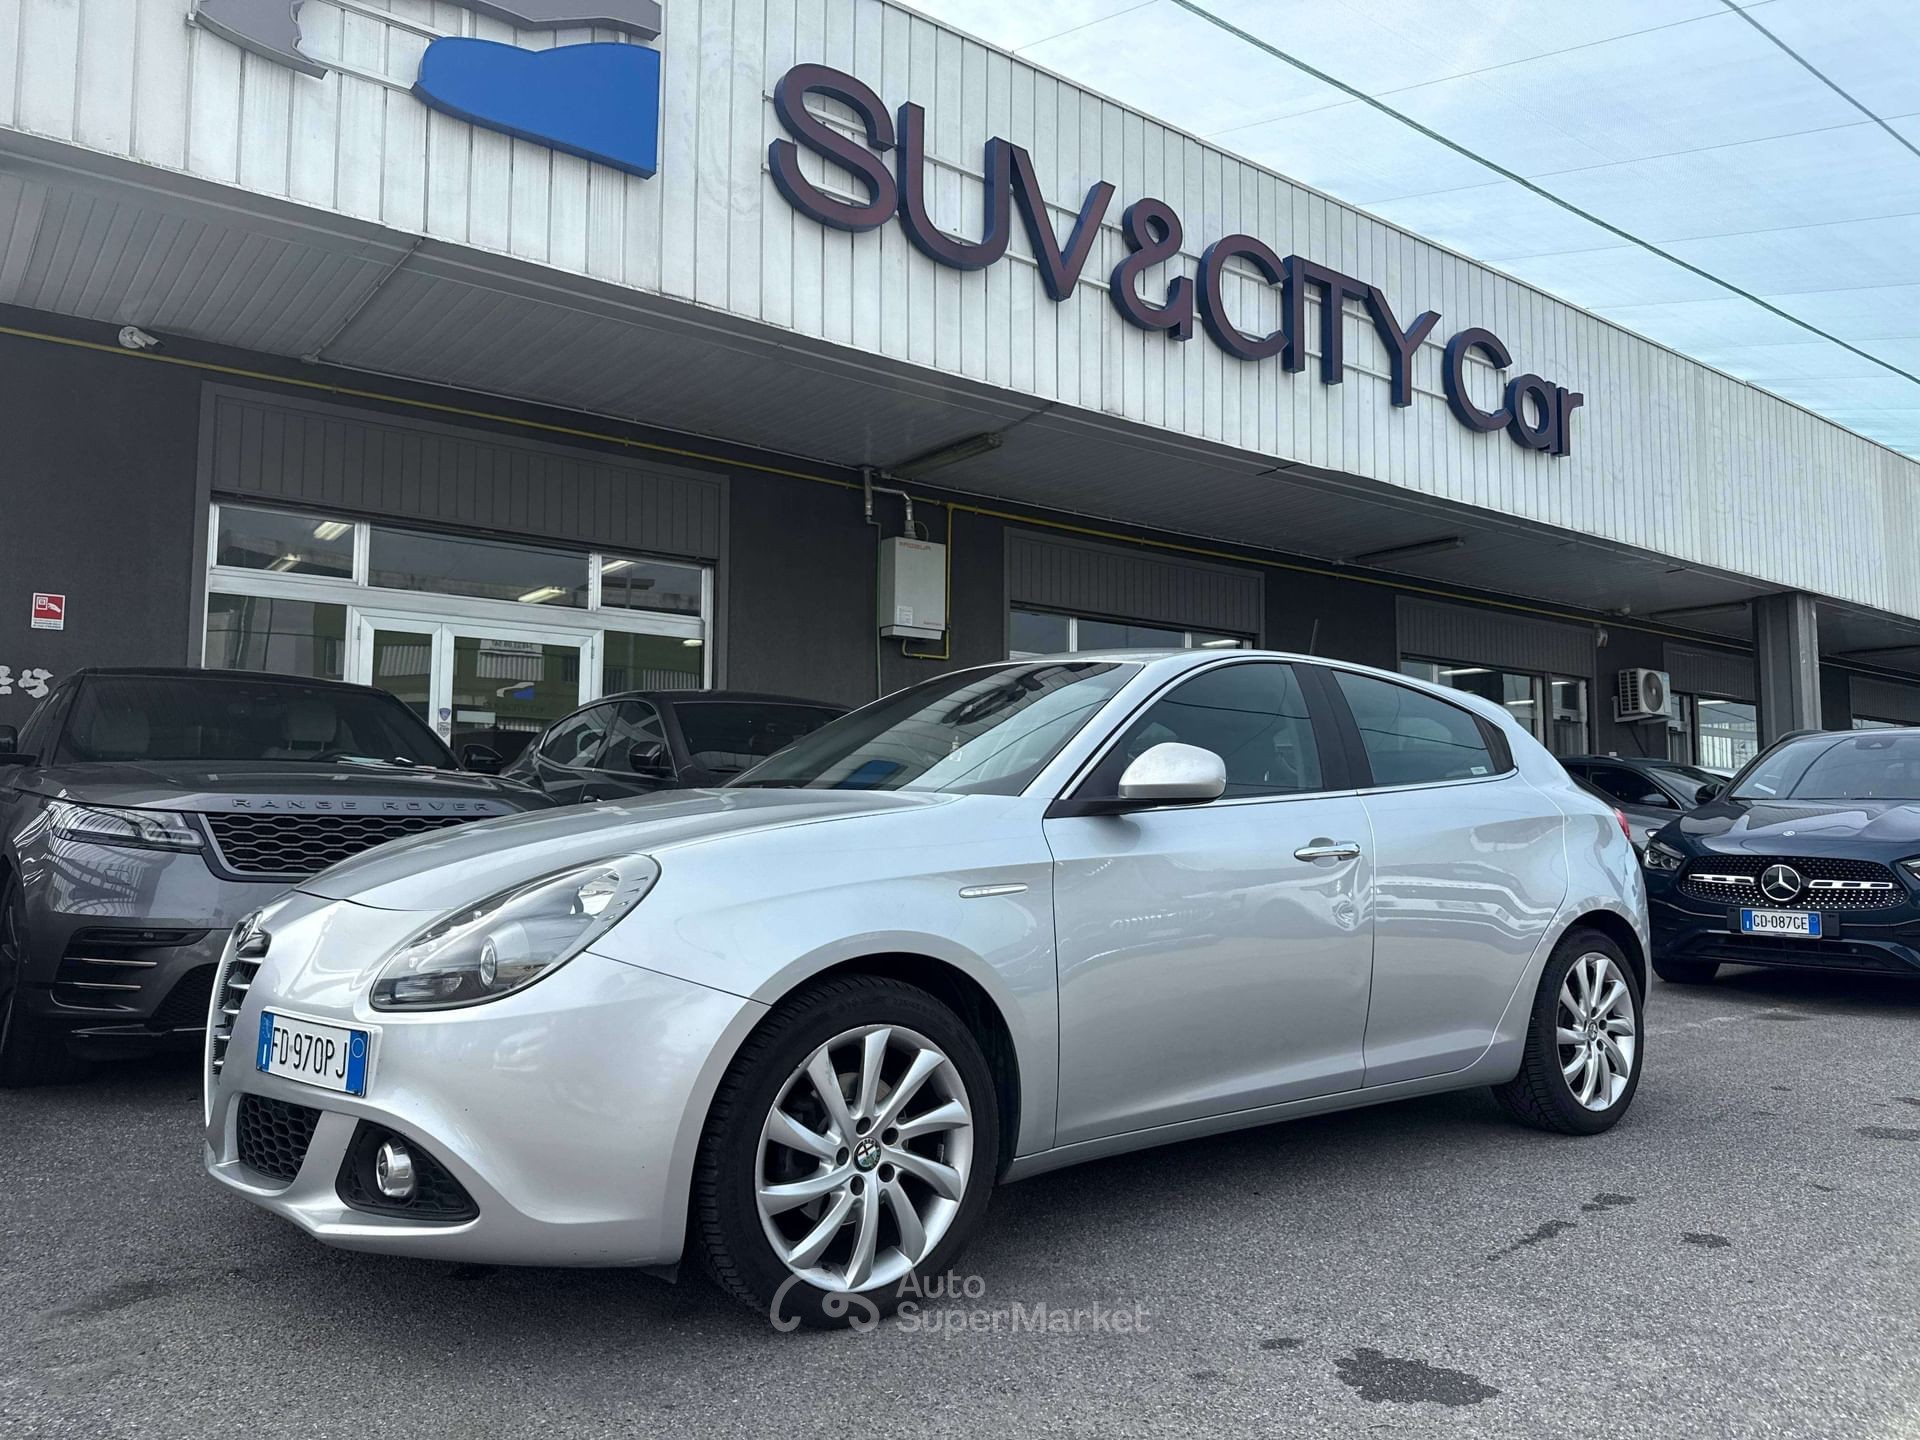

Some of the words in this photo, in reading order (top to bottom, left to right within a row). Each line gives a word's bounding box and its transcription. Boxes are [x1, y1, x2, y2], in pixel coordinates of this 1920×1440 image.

[769, 63, 1441, 407] SUV&CITY
[1443, 327, 1584, 456] Car
[231, 798, 358, 810] RANGE
[382, 801, 489, 811] ROVER
